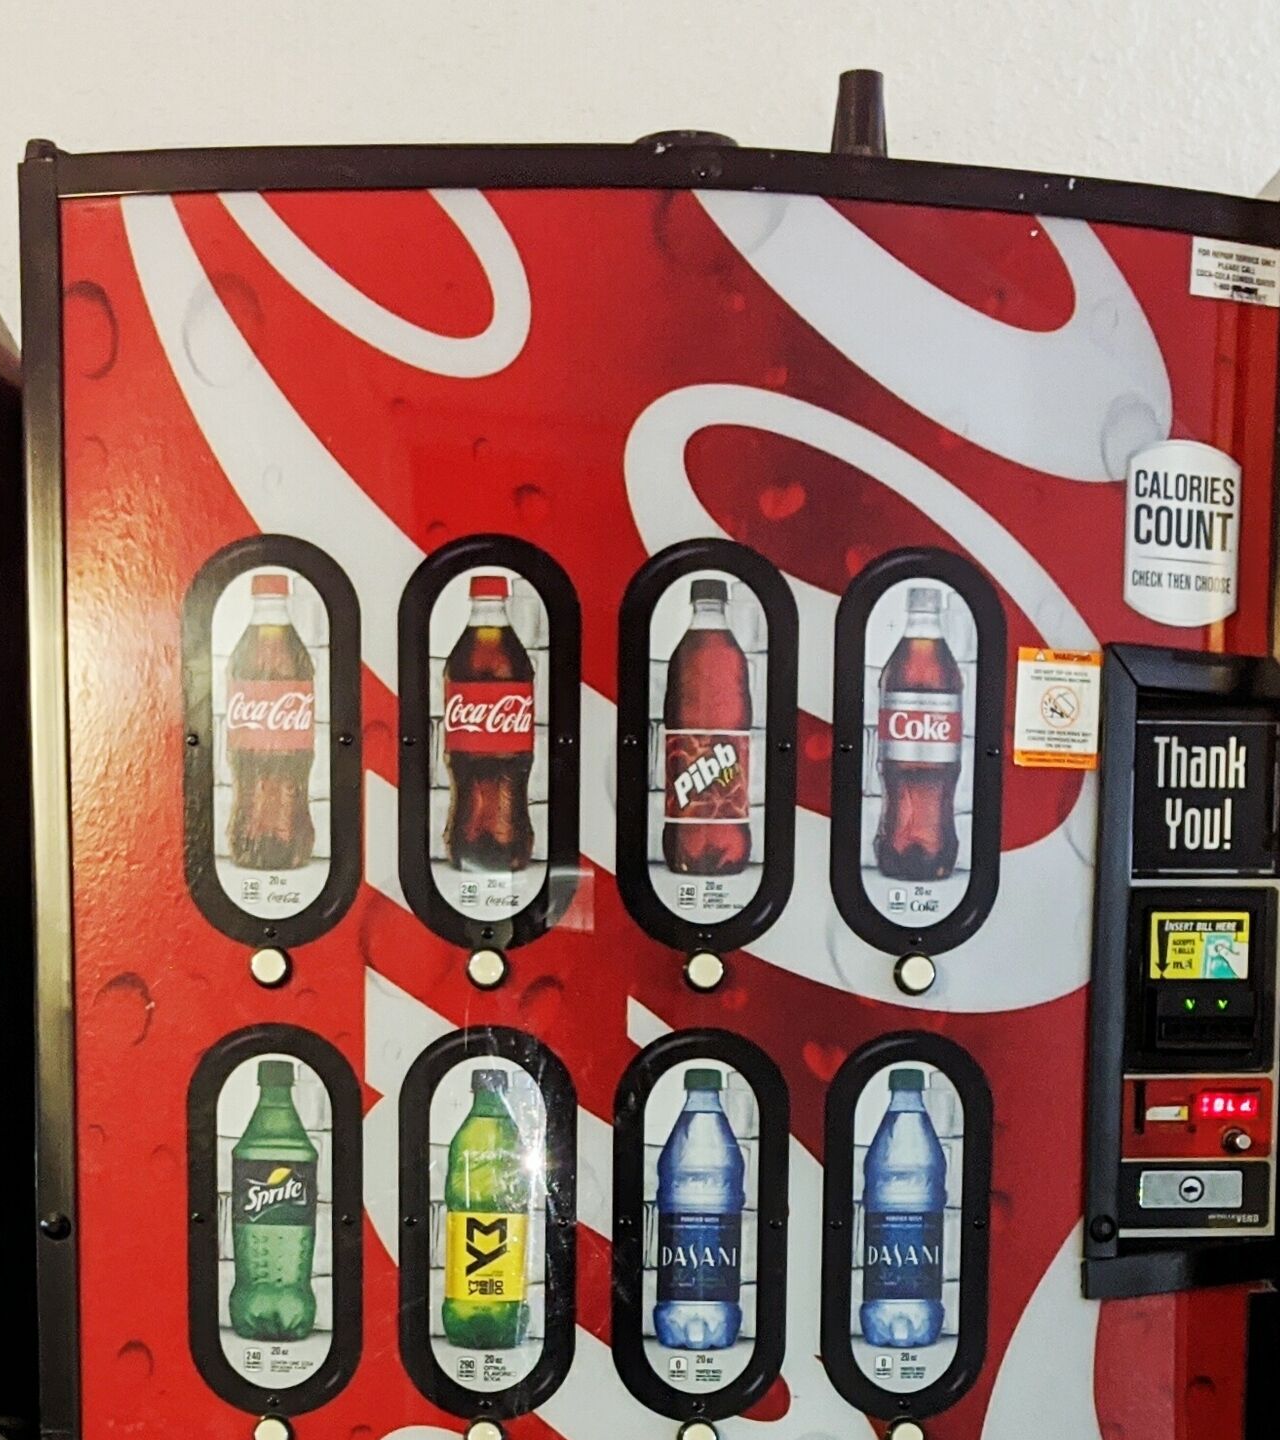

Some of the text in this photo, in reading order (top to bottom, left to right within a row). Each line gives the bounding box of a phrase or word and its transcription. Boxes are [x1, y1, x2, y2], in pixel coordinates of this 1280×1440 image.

[1134, 469, 1235, 506] CALORIES
[1131, 569, 1232, 595] CHECK THEN CHOOSE
[225, 690, 314, 732] Coca-Cola
[445, 693, 533, 734] Coca-Cola
[888, 711, 951, 741] Coke
[1153, 736, 1247, 789] Thank
[674, 743, 738, 809] Pibb
[1165, 797, 1232, 850] You!
[1164, 919, 1238, 932] INSERT BILL HERE
[243, 1178, 304, 1214] Sprite
[661, 1244, 737, 1270] DASANI
[867, 1243, 939, 1268] DASANI
[246, 1351, 261, 1361] 240
[459, 1359, 475, 1370] 290
[484, 1354, 494, 1364] 20
[696, 1355, 706, 1365] 20
[900, 1352, 910, 1362] 20
